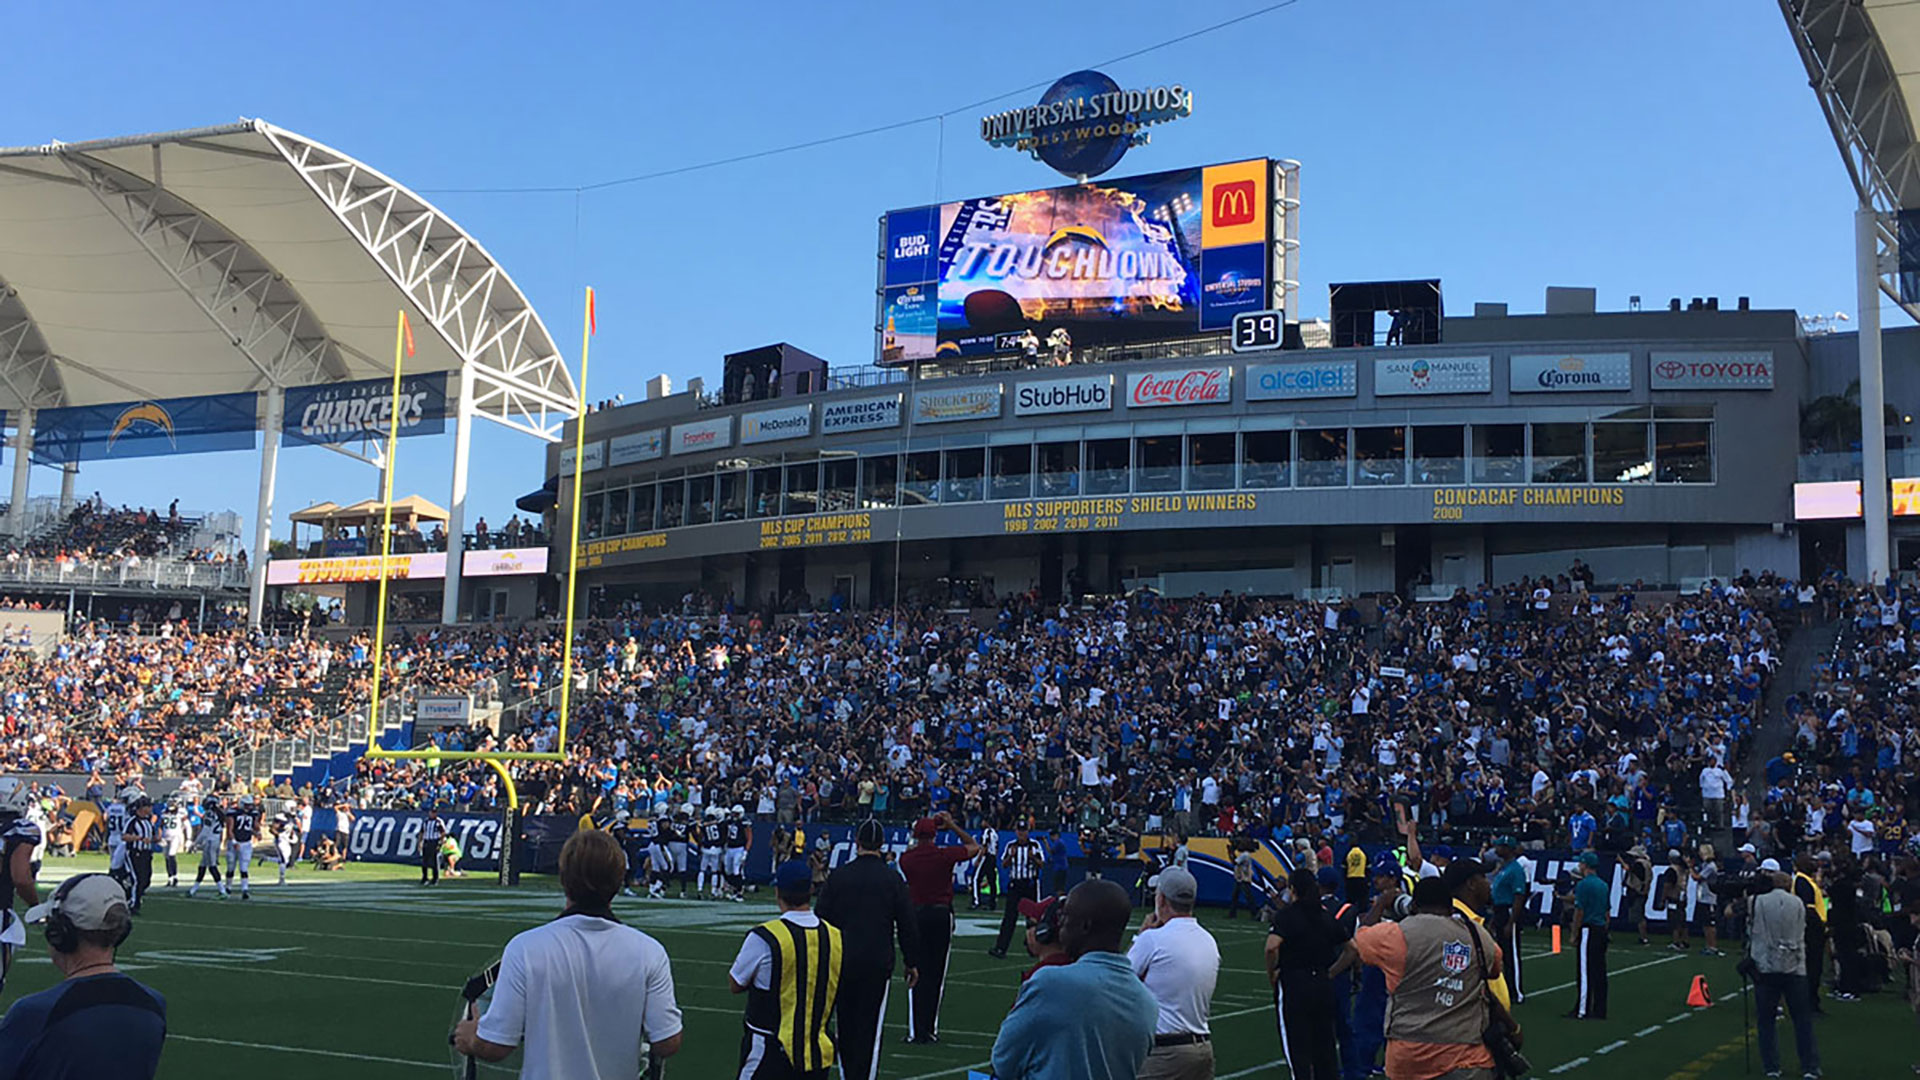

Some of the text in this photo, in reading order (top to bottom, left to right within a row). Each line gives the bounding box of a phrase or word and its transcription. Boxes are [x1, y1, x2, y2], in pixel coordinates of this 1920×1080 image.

[981, 85, 1184, 140] UNIVERSAL STUDIOS
[1017, 122, 1138, 151] HOLLYWOOD
[899, 234, 927, 248] BUD
[894, 244, 931, 258] LIGHT
[958, 242, 1177, 281] TOUCHDOWN
[1242, 317, 1275, 345] 39
[1386, 362, 1479, 374] SAN MANUEL
[1686, 361, 1769, 378] TOYOTA
[1134, 370, 1222, 405] Coca-Cola
[1259, 367, 1344, 391] alcatel
[1537, 368, 1601, 389] Corona
[1018, 384, 1106, 408] StubHub
[300, 391, 428, 436] CHARGERS
[825, 399, 897, 417] AMERICAN
[759, 416, 808, 432] McDonald's
[824, 412, 884, 428] EXPRESS
[682, 430, 717, 445] Frontier
[1433, 487, 1625, 506] CONCACAF CHAMPIONS
[1004, 494, 1257, 519] MLS SUPPORTERS' SHIELD WINNERS
[1432, 507, 1463, 520] 2000
[761, 513, 871, 536] MLS CUP CHAMPIONS
[1004, 520, 1028, 532] 1998
[1094, 516, 1119, 528] 2011
[236, 815, 253, 831] 73
[705, 823, 720, 841] 16
[350, 816, 504, 860] GO BTS!
[1446, 954, 1468, 971] NFL
[1435, 991, 1454, 1007] 148
